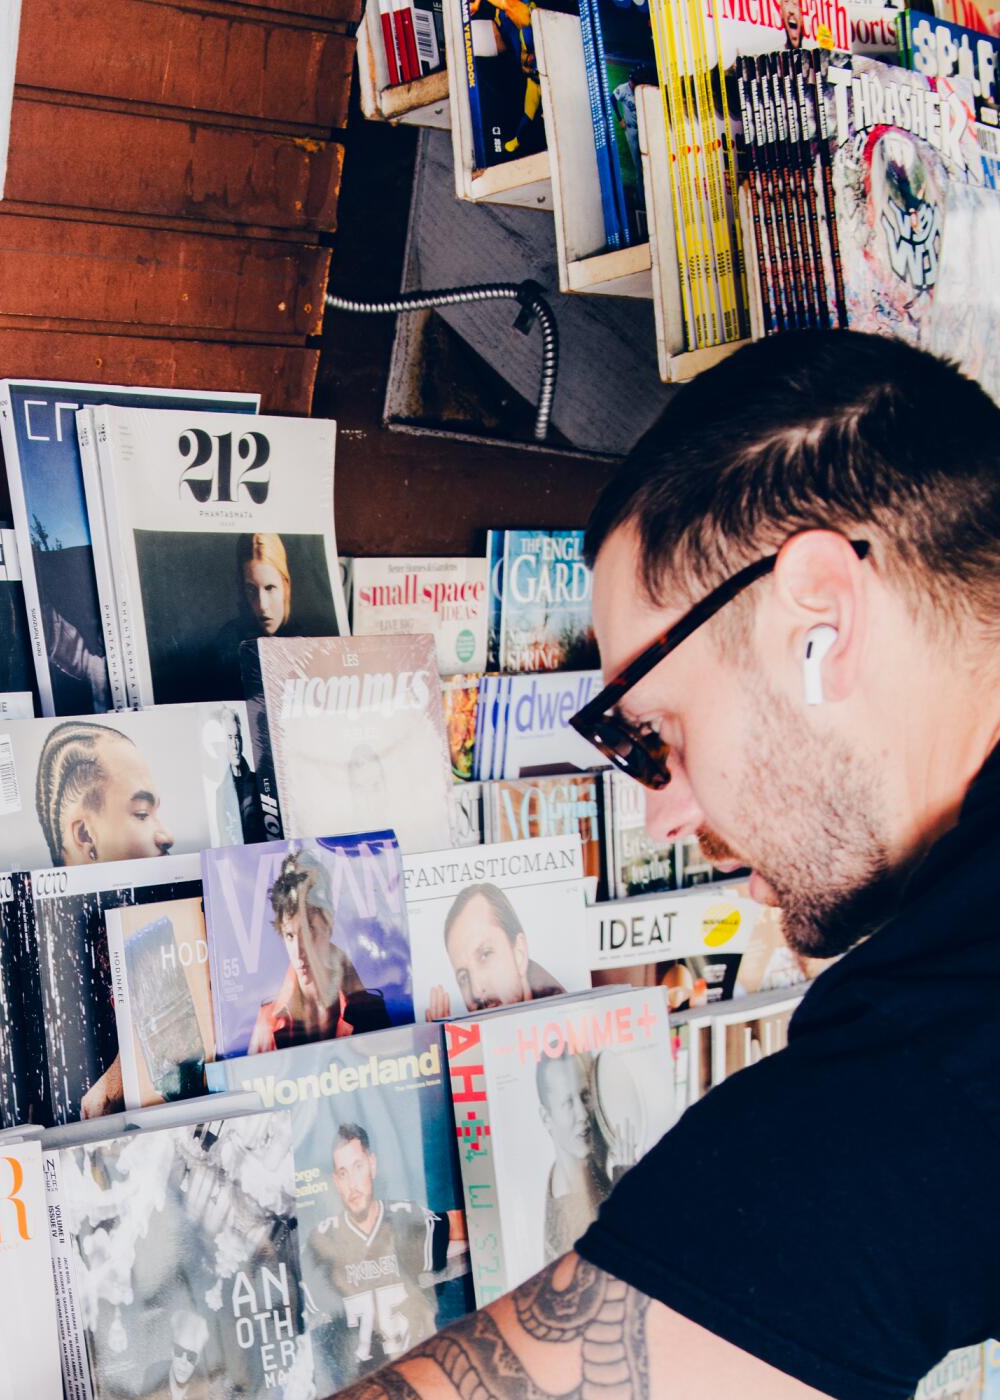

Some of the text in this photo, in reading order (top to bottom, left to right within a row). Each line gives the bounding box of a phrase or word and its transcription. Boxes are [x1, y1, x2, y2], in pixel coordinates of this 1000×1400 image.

[463, 24, 476, 88] YEARBOOK
[826, 66, 978, 186] THRASHER
[178, 428, 271, 504] 212
[520, 538, 540, 553] THE
[358, 574, 485, 613] small space
[511, 554, 592, 604] GARD
[440, 607, 478, 622] IDEAS
[341, 654, 360, 667] LES
[508, 650, 560, 671] SPRING
[263, 778, 271, 793] LES
[599, 911, 679, 952] IDEAT
[114, 951, 125, 1006] HODINKEE
[241, 1043, 442, 1108] Wonderland
[48, 1205, 57, 1229] ISSUE
[54, 1204, 63, 1232] VOLUME
[231, 1262, 290, 1318] AN
[235, 1307, 294, 1350] OTH
[342, 1282, 410, 1363] 75
[260, 1340, 297, 1371] ER
